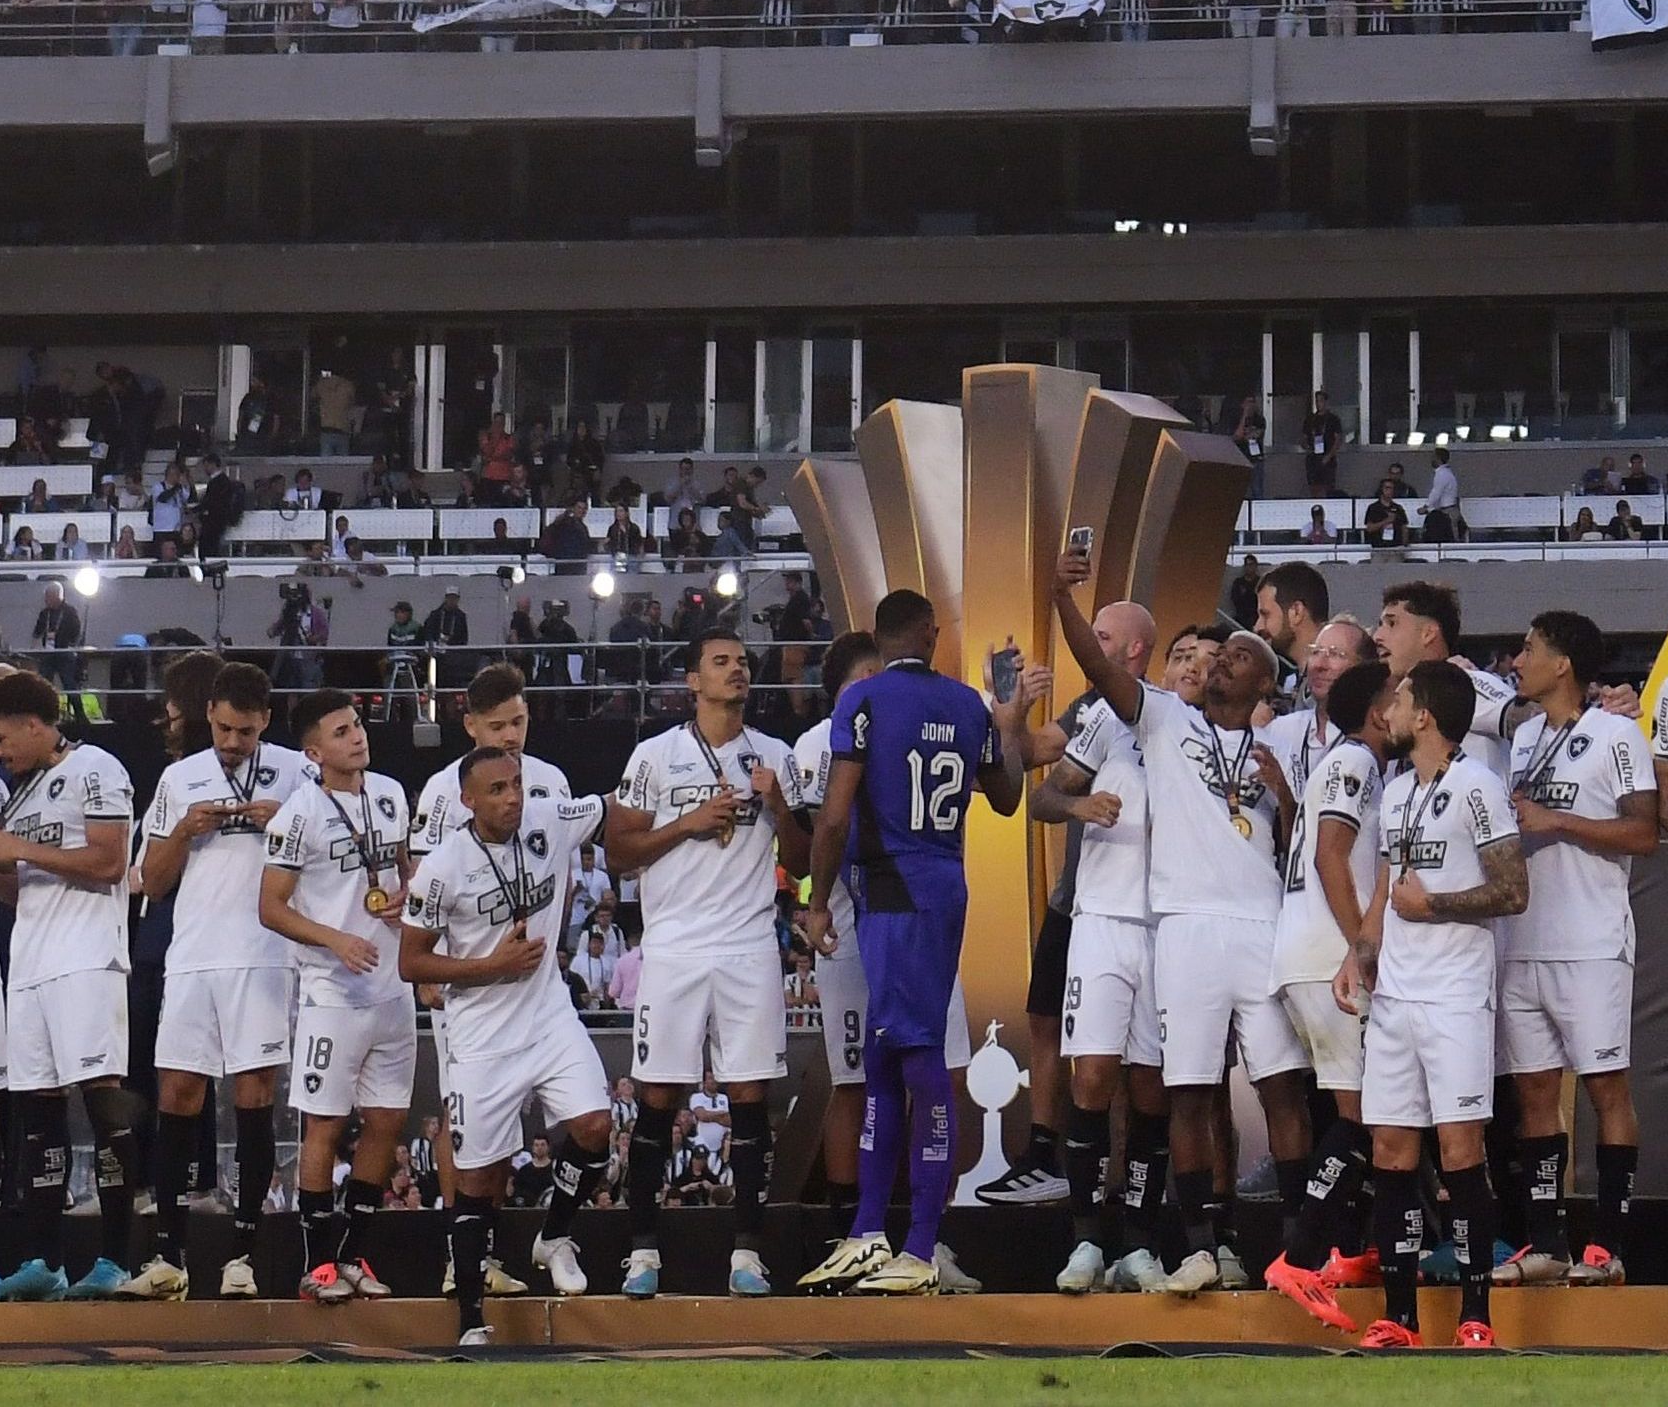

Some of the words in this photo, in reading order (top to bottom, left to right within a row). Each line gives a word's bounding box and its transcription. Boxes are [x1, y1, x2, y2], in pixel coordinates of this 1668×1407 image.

[1475, 676, 1507, 702] entrum
[922, 723, 956, 743] JOHN
[1076, 706, 1107, 755] Centrum
[630, 759, 648, 809] Centrum
[906, 748, 965, 832] 12
[427, 794, 446, 846] Centrum
[1471, 788, 1492, 841] Centrum
[423, 878, 441, 929] Centrum
[638, 1004, 651, 1039] 5
[844, 1009, 861, 1044] 9
[305, 1035, 333, 1071] 18
[926, 1103, 949, 1158] Lifefit
